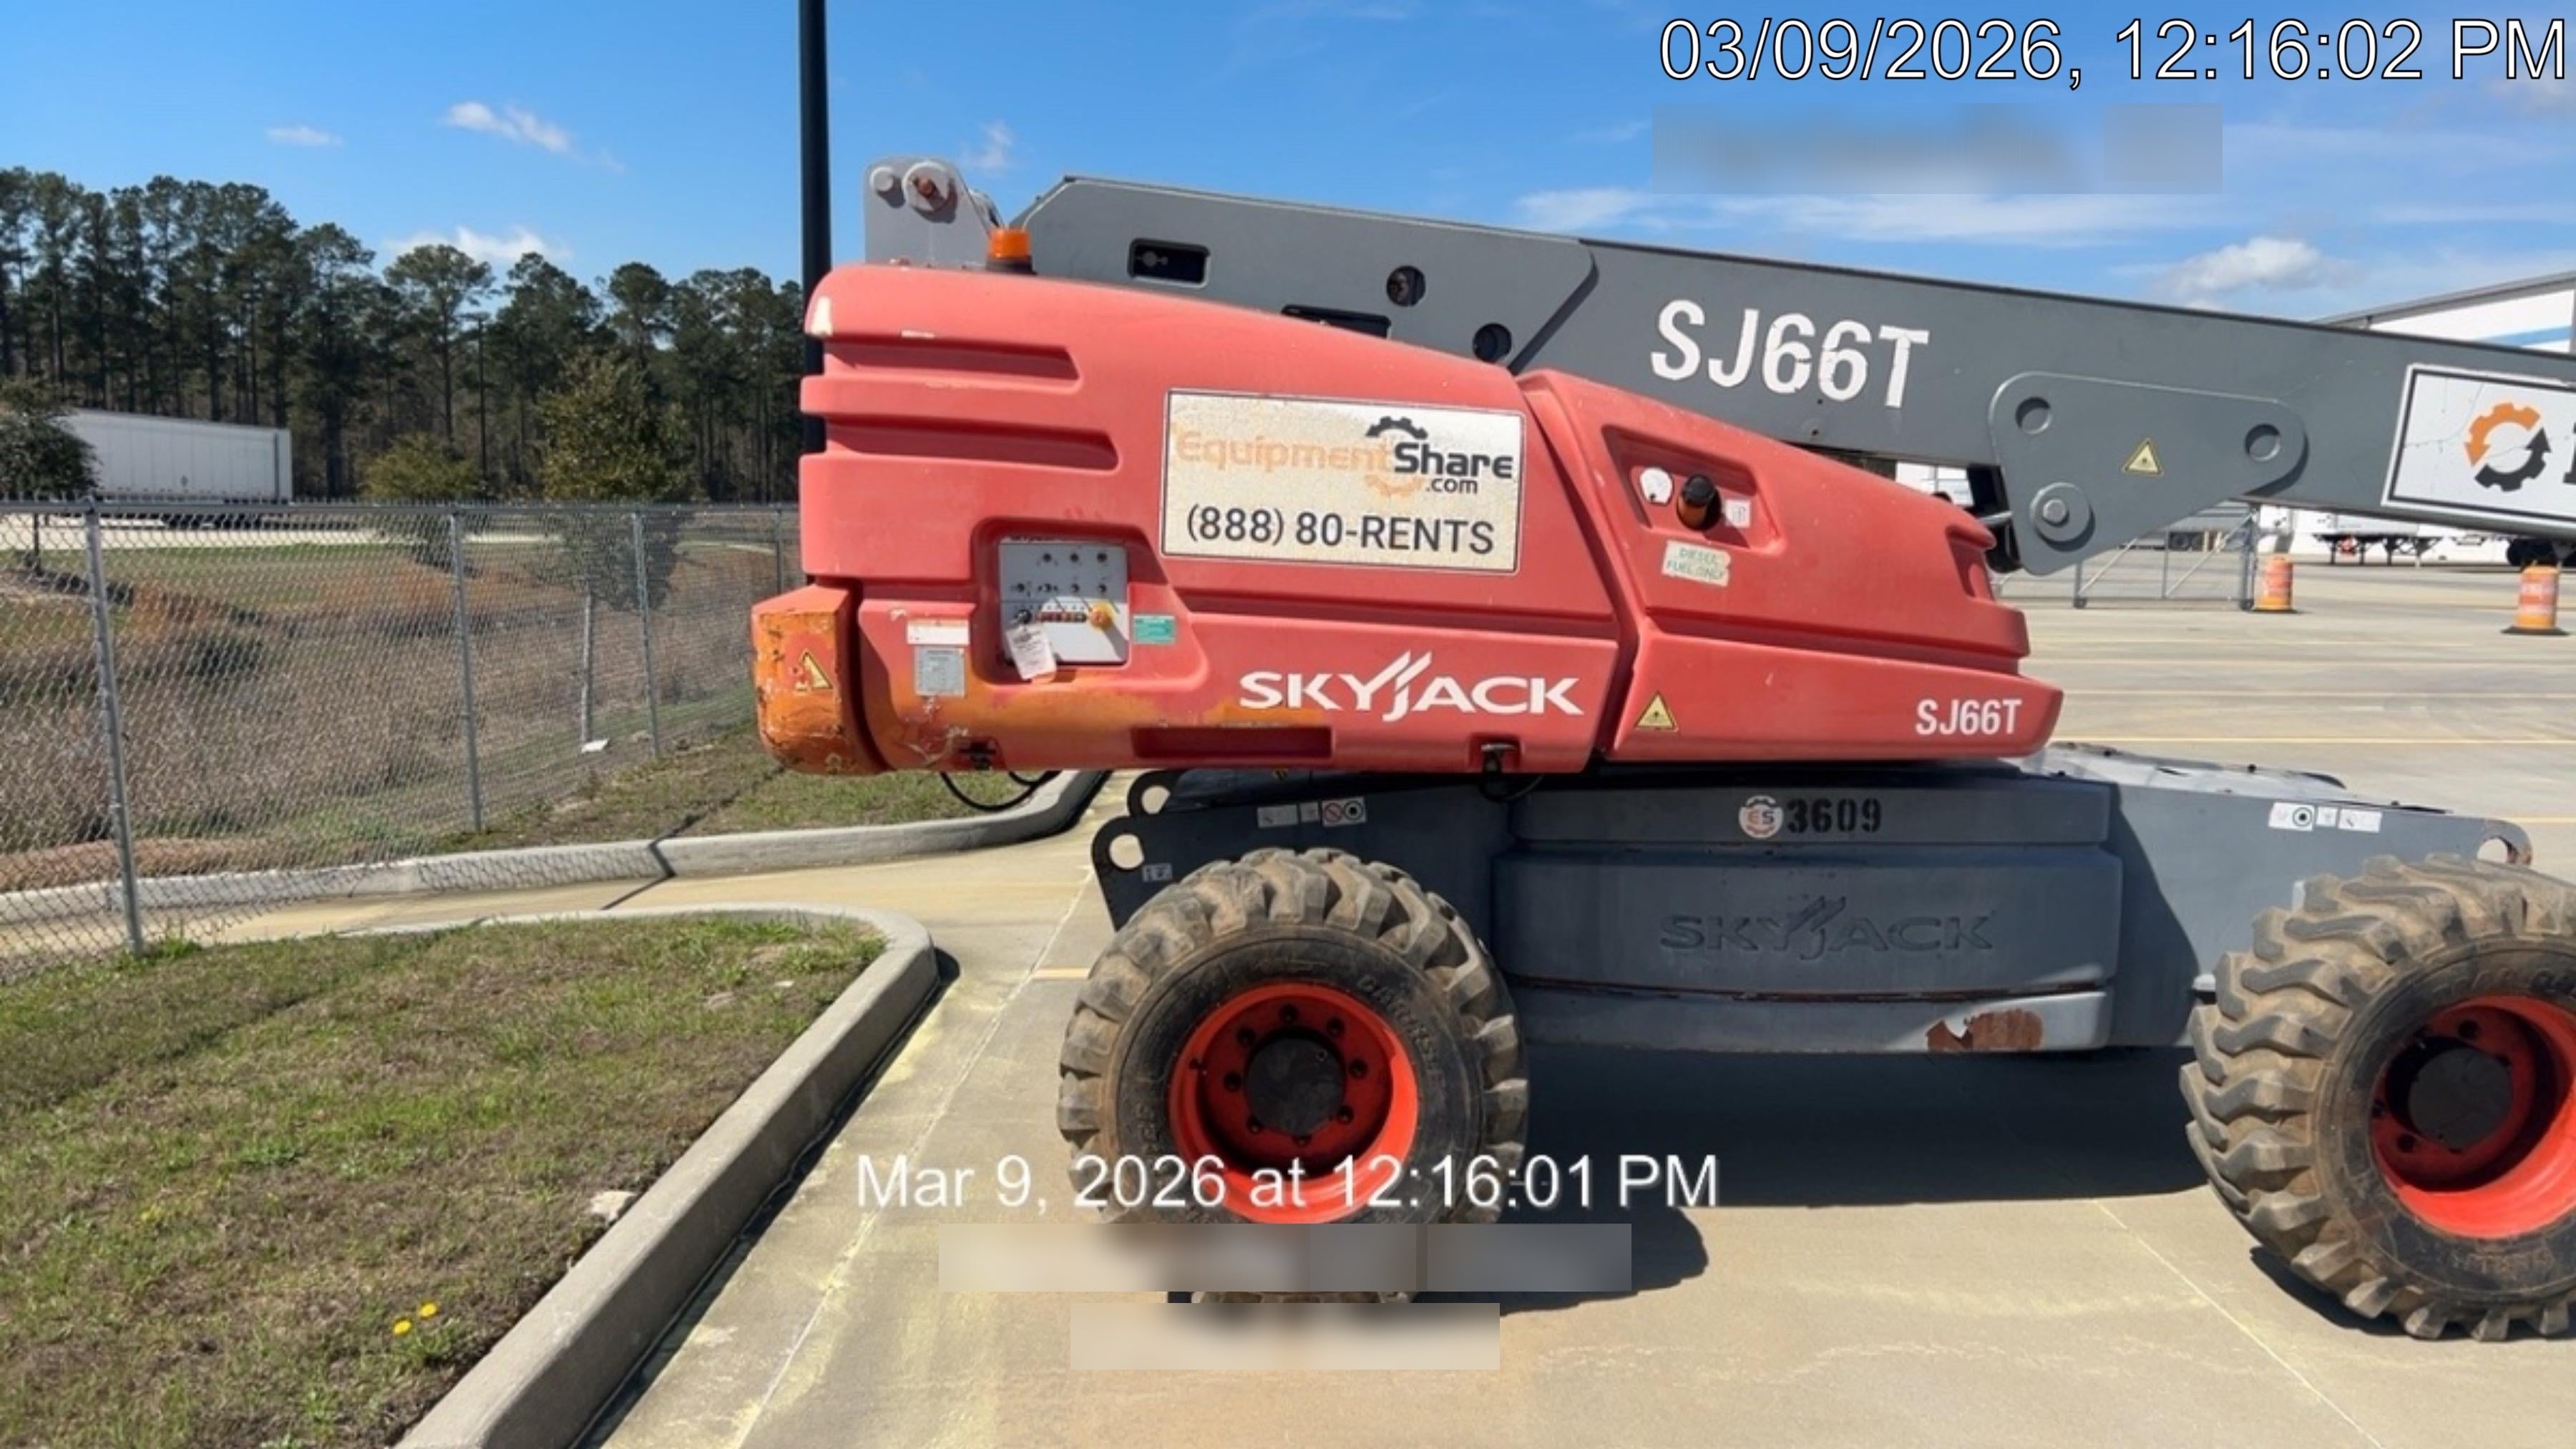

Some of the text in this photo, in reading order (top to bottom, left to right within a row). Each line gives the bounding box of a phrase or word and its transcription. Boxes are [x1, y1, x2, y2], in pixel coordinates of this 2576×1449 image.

[1650, 299, 1930, 409] SJ66T
[1426, 477, 1478, 494] .com
[1187, 504, 1495, 555] (888) 80-RENTS
[1239, 650, 1584, 722] SKYJACK
[1915, 698, 2023, 735] SJ66T
[1787, 797, 1881, 834] 3609
[1659, 896, 1994, 960] SKYJACK
